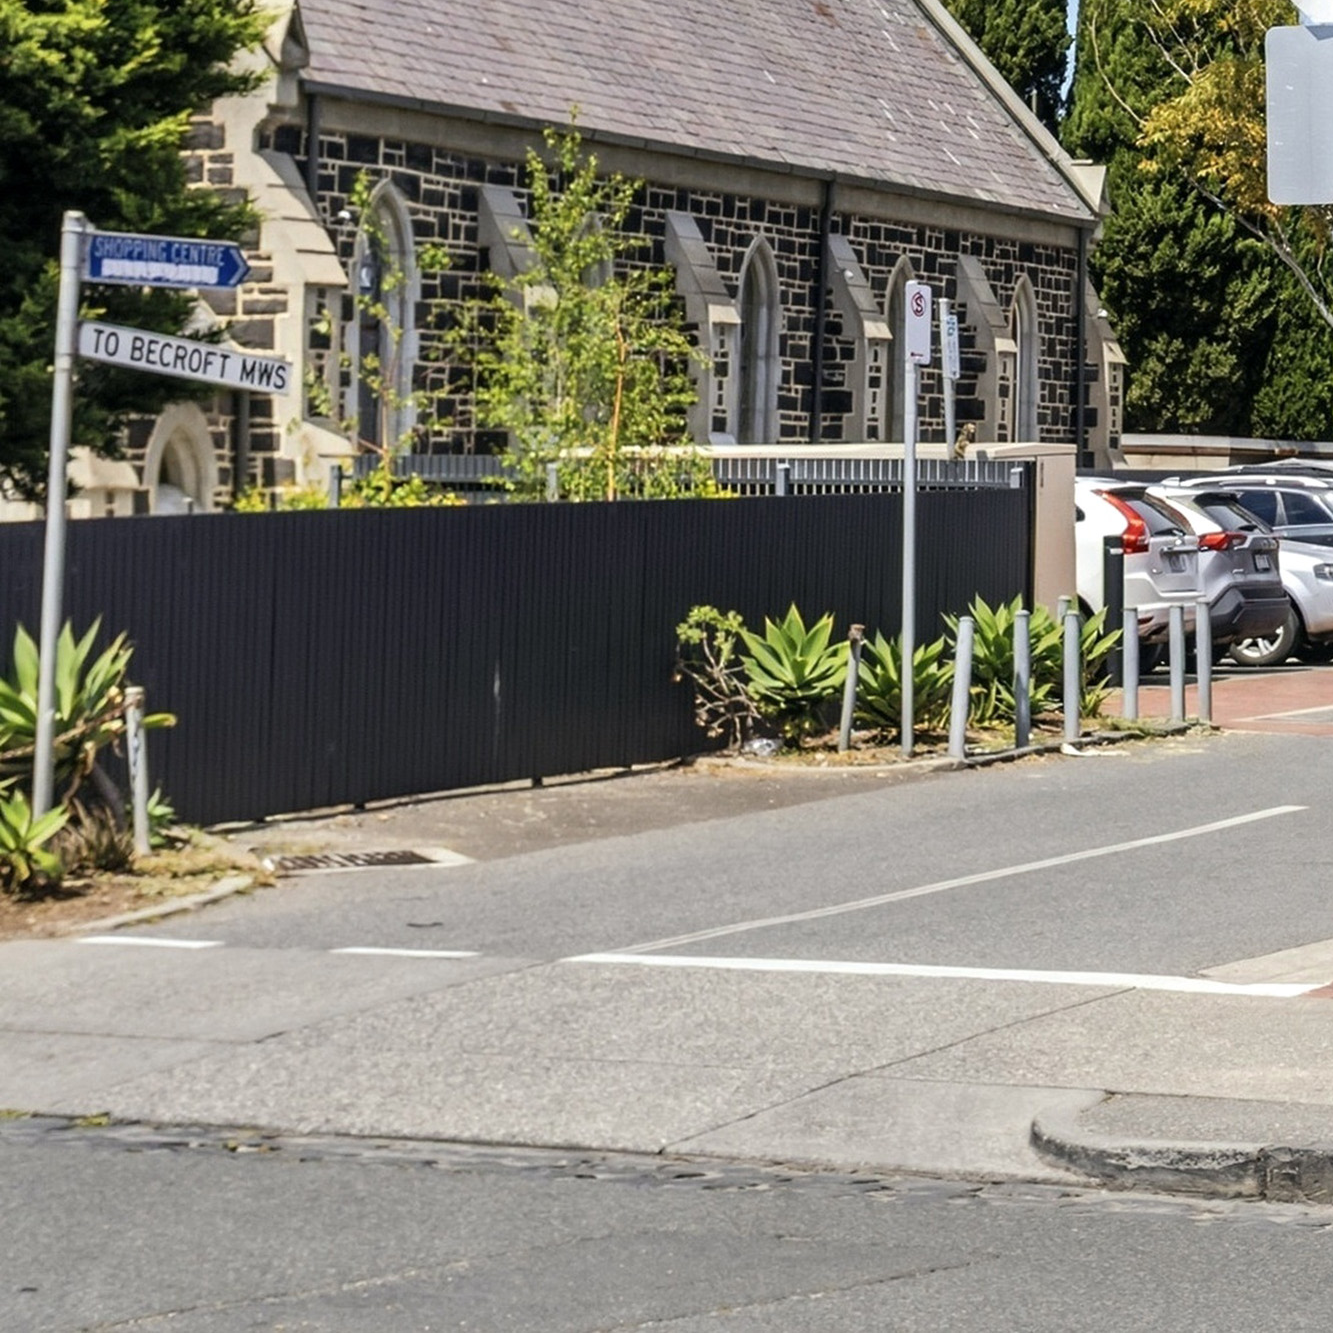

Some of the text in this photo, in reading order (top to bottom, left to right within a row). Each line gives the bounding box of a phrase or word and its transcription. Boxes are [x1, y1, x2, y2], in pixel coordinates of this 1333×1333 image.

[94, 237, 226, 266] SHOPPING CENTRE
[93, 328, 287, 390] TO BECROFT MWS
